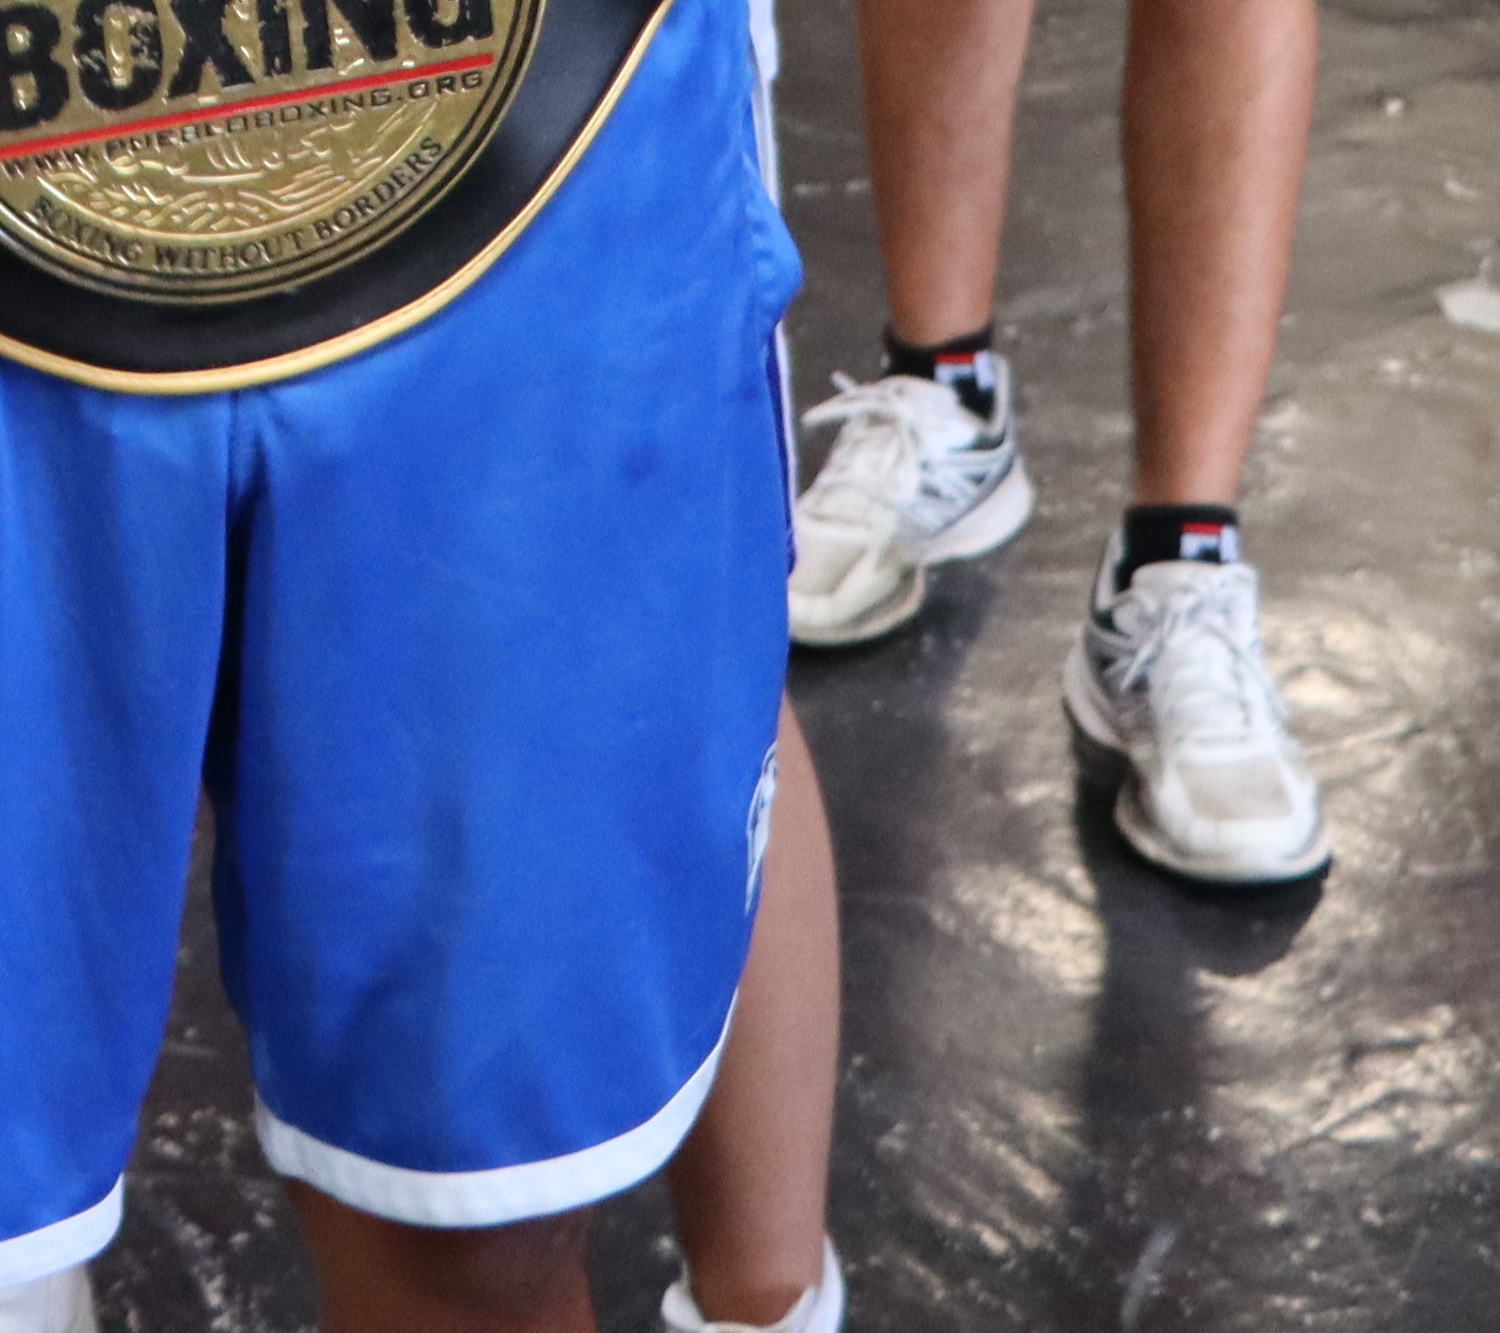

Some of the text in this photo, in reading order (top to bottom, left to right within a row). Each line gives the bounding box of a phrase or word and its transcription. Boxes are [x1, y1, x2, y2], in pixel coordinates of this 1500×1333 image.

[26, 136, 444, 271] BOXING WITHOUT BORDERS
